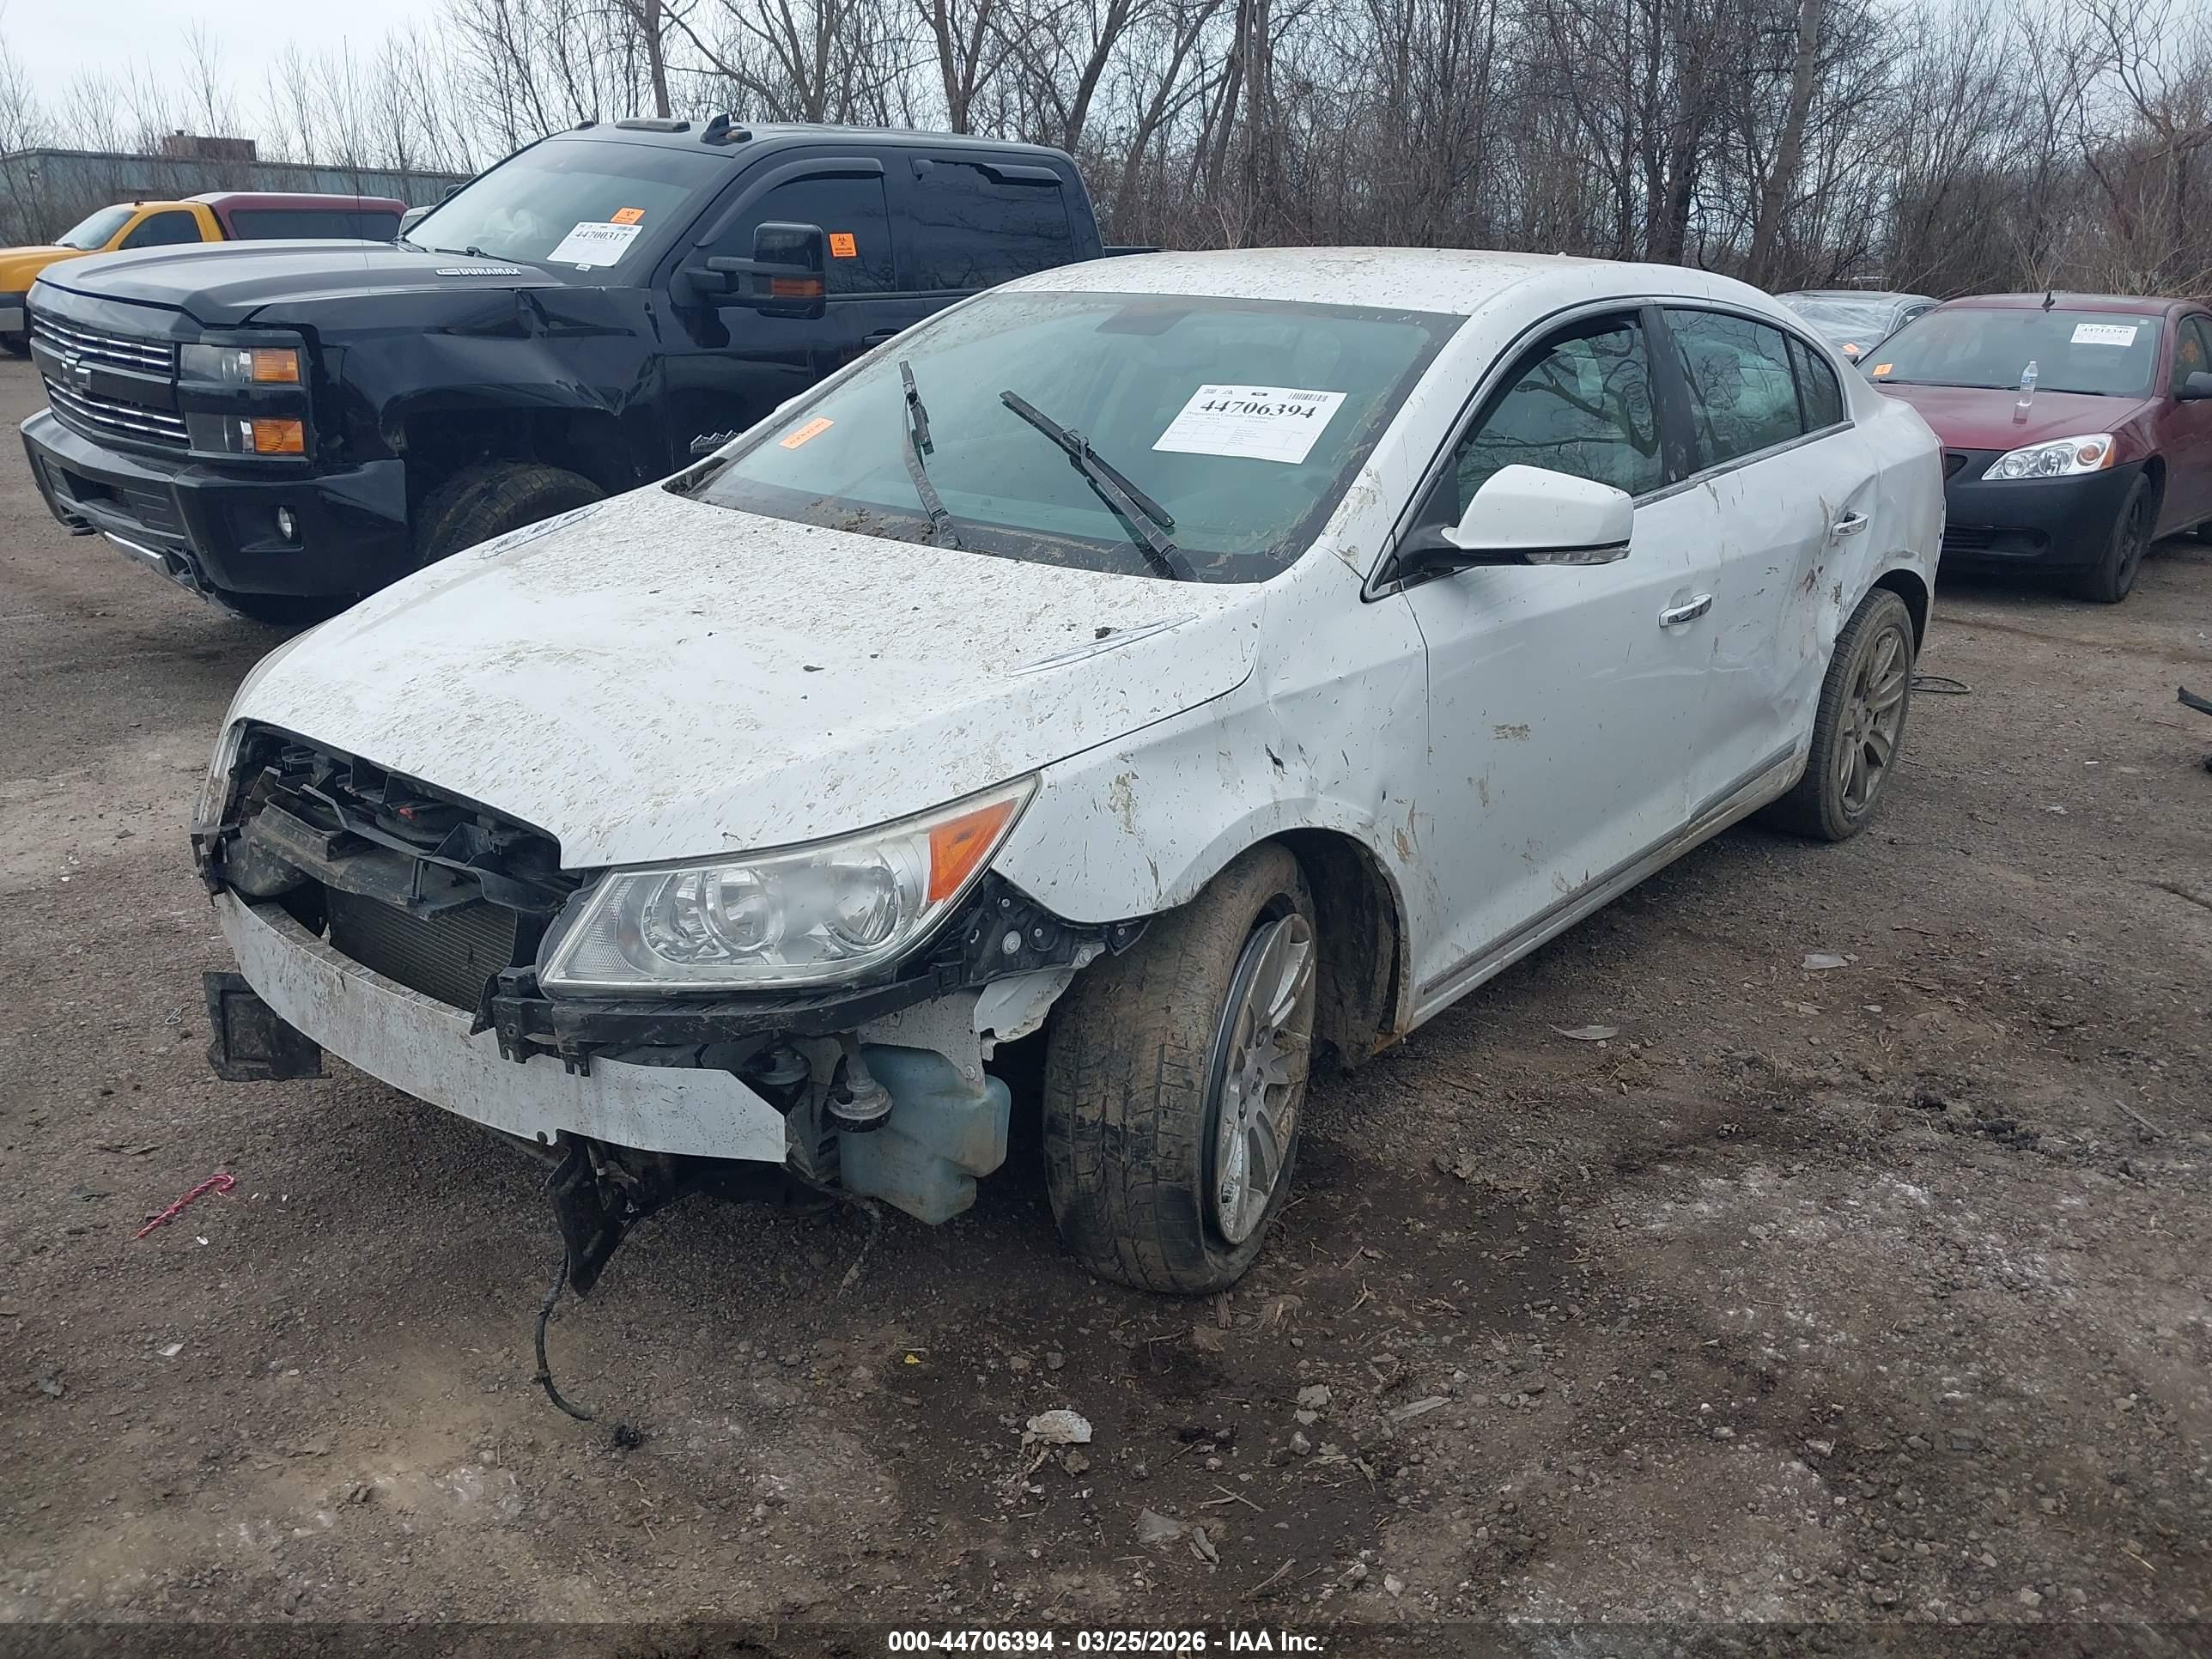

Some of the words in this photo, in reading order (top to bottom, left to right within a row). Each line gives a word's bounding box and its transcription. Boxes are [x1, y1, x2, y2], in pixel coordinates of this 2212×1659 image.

[574, 230, 628, 241] 44700317
[457, 267, 521, 276] DURAMAX
[1200, 399, 1317, 419] 44706394
